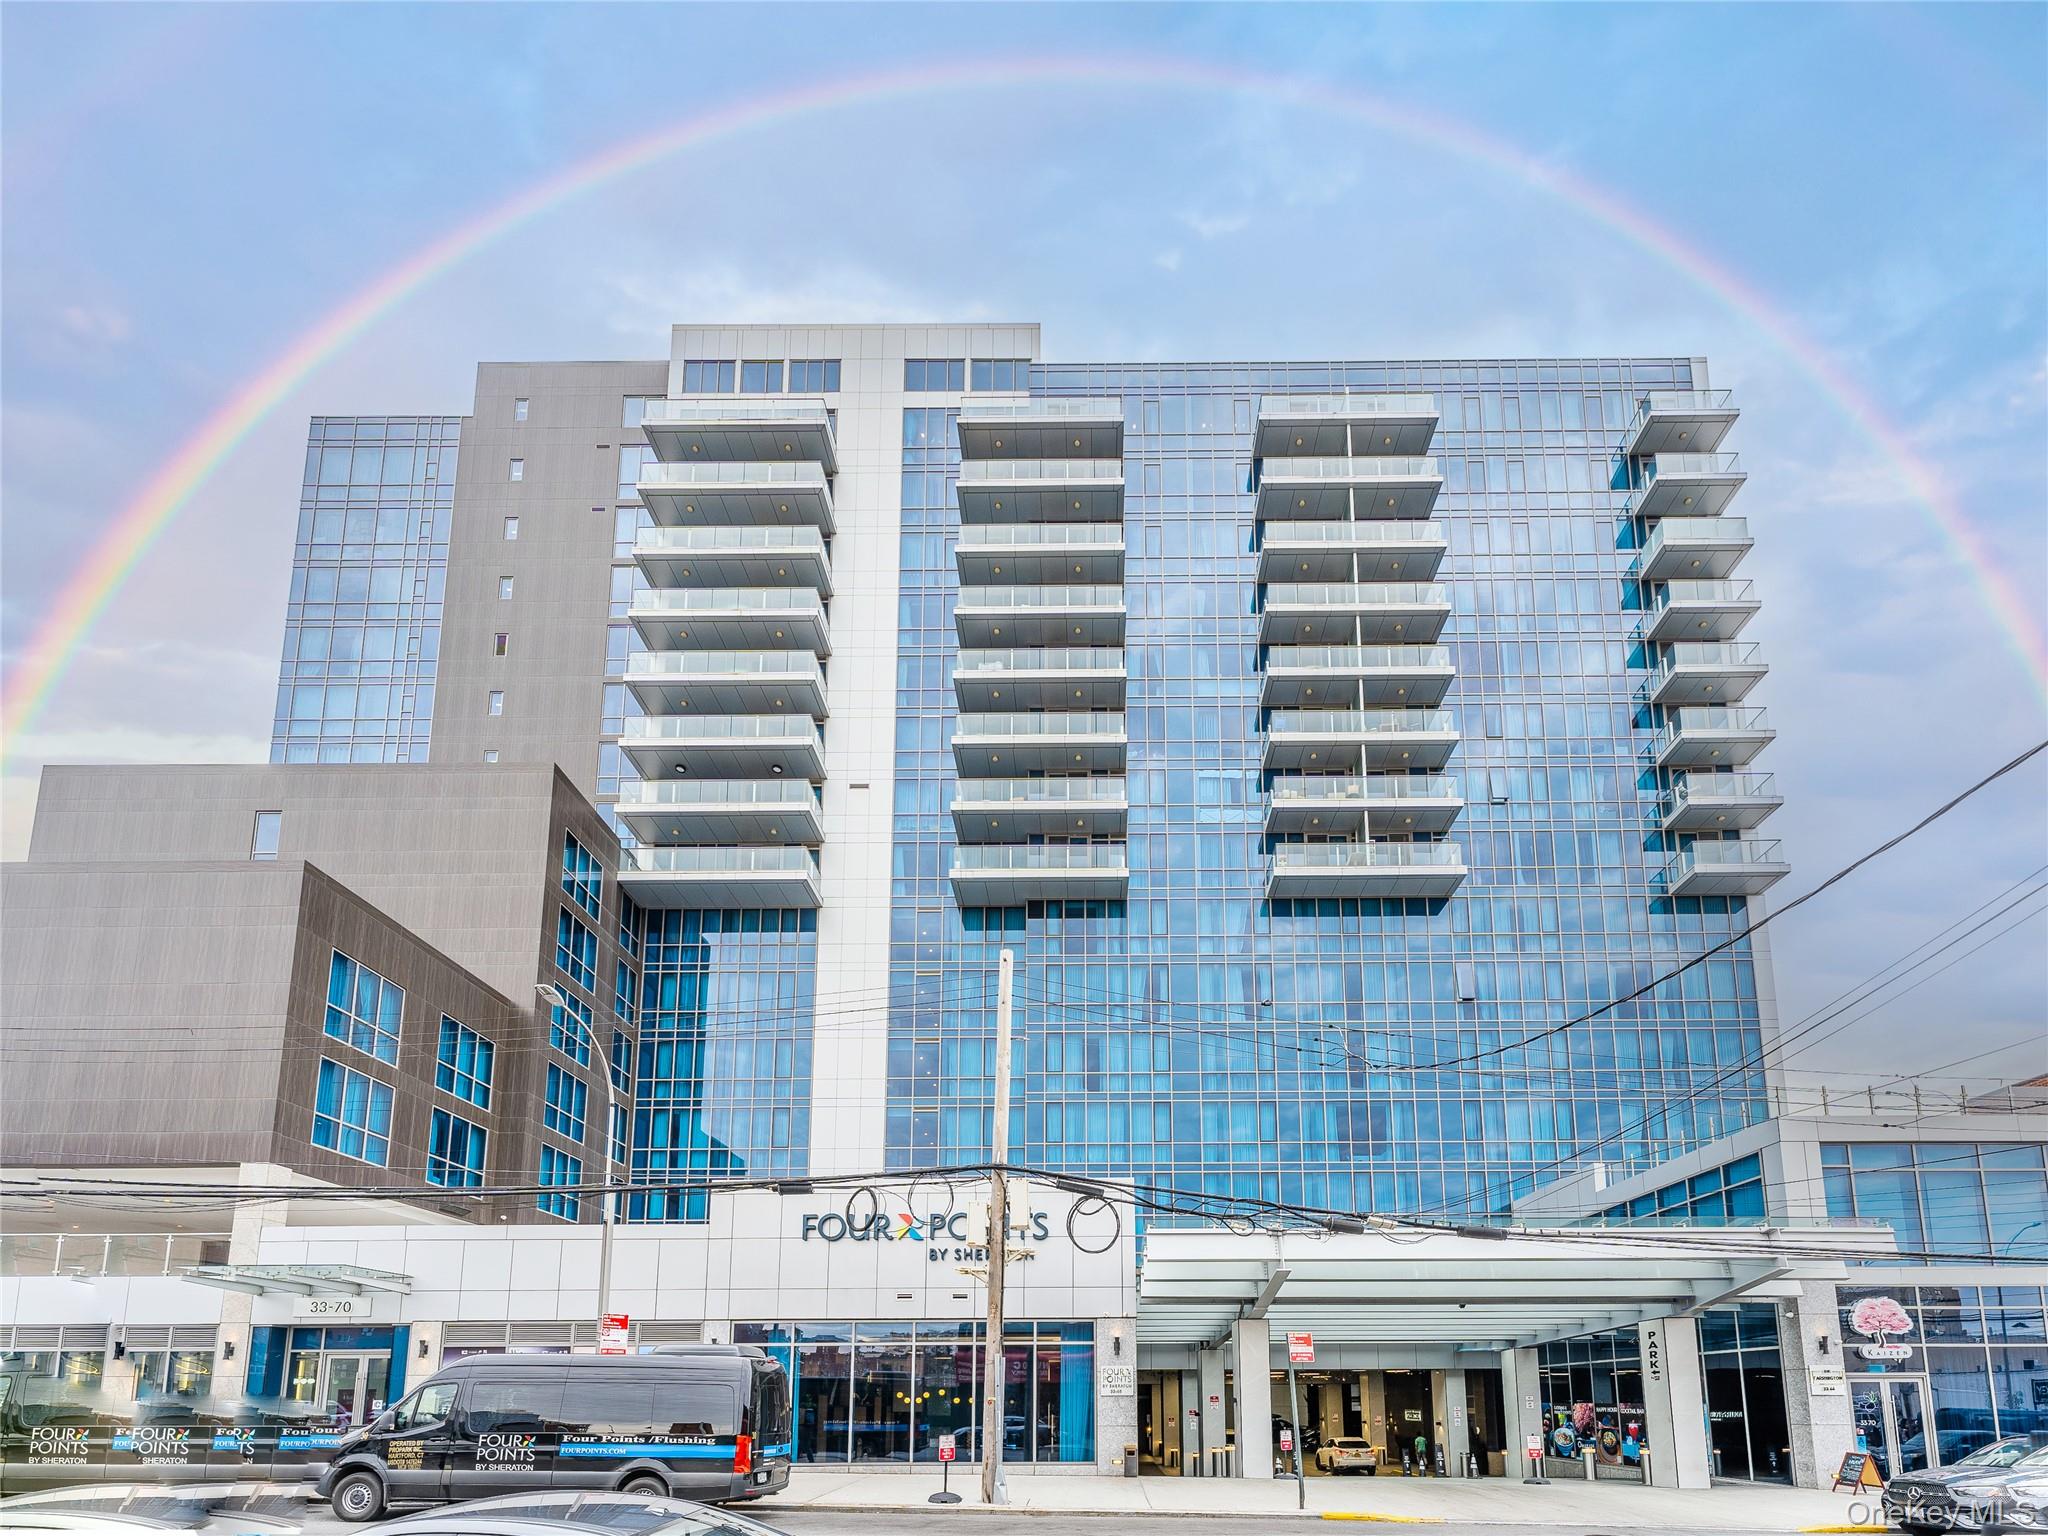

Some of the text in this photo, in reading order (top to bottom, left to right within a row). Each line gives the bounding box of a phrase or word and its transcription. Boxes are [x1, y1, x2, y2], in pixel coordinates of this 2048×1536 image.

[802, 1213, 894, 1242] FOUR
[929, 1247, 948, 1261] BY
[310, 1301, 352, 1313] 33-70
[1647, 1331, 1659, 1369] PARK
[1102, 1368, 1125, 1376] FOUR
[1102, 1375, 1132, 1383] POINTS
[31, 1427, 77, 1441] FOUR
[131, 1427, 177, 1441] FOUR
[562, 1434, 598, 1443] Four
[601, 1434, 645, 1443] Points
[29, 1441, 89, 1454] POINTS
[130, 1441, 189, 1454] POINTS
[478, 1434, 524, 1448] FOUR
[476, 1448, 536, 1461] POINTS
[561, 1447, 627, 1455] FOURPOINTS.COM
[475, 1463, 534, 1471] BY SHERATON
